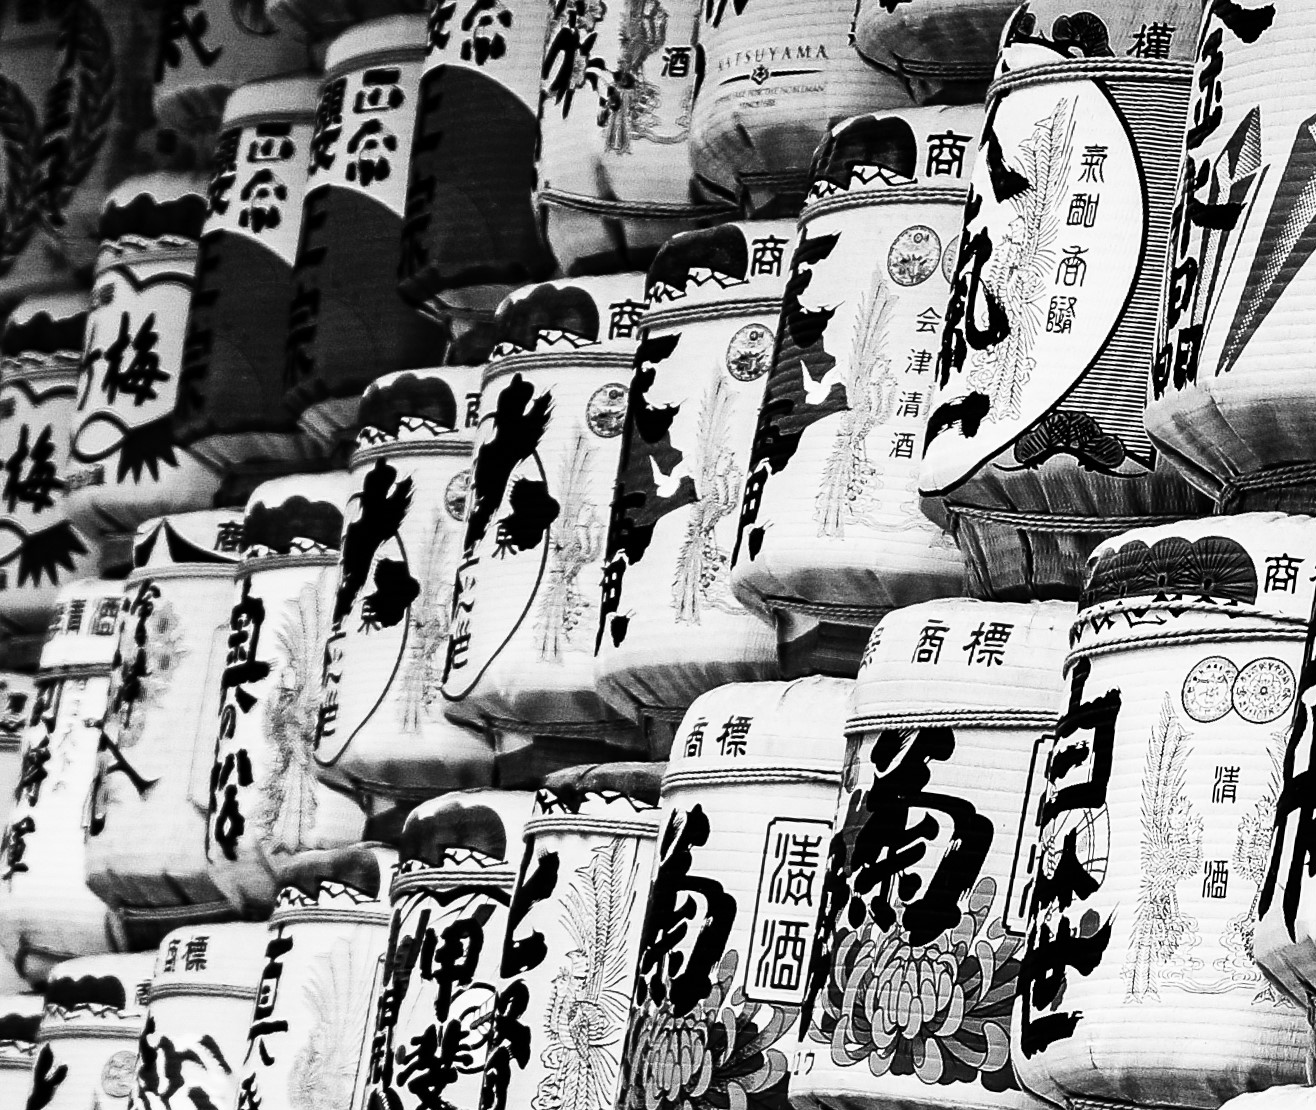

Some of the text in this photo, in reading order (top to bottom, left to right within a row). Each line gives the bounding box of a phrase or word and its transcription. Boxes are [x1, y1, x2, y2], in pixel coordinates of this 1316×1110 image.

[888, 305, 942, 460] 会津清酒
[1200, 764, 1240, 901] 清酒
